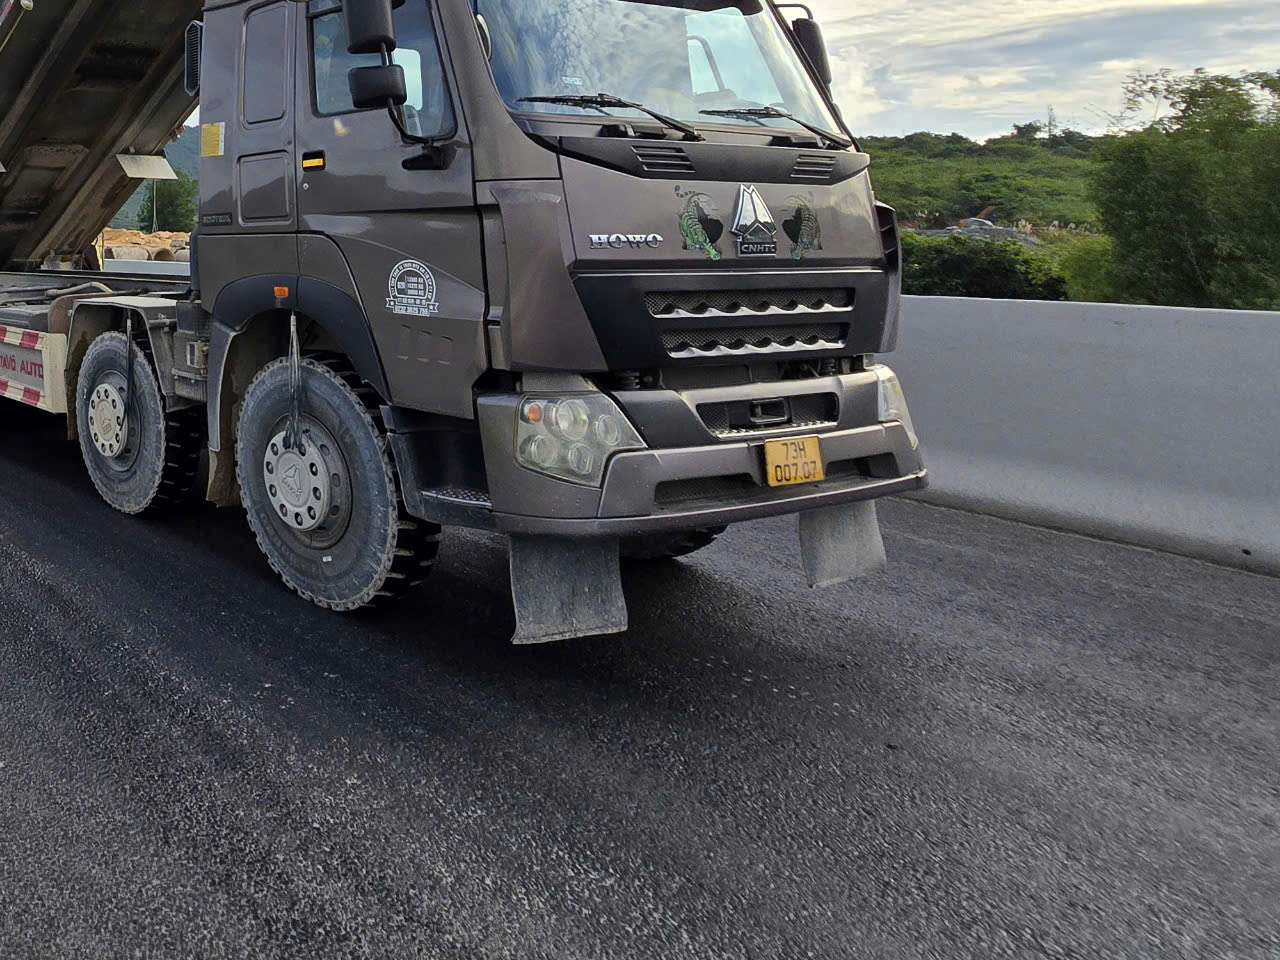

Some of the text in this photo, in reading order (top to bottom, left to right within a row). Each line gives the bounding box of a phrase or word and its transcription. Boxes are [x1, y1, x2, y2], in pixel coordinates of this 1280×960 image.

[589, 233, 664, 250] HOWO
[781, 440, 807, 461] 73H
[774, 460, 817, 483] 007.07
